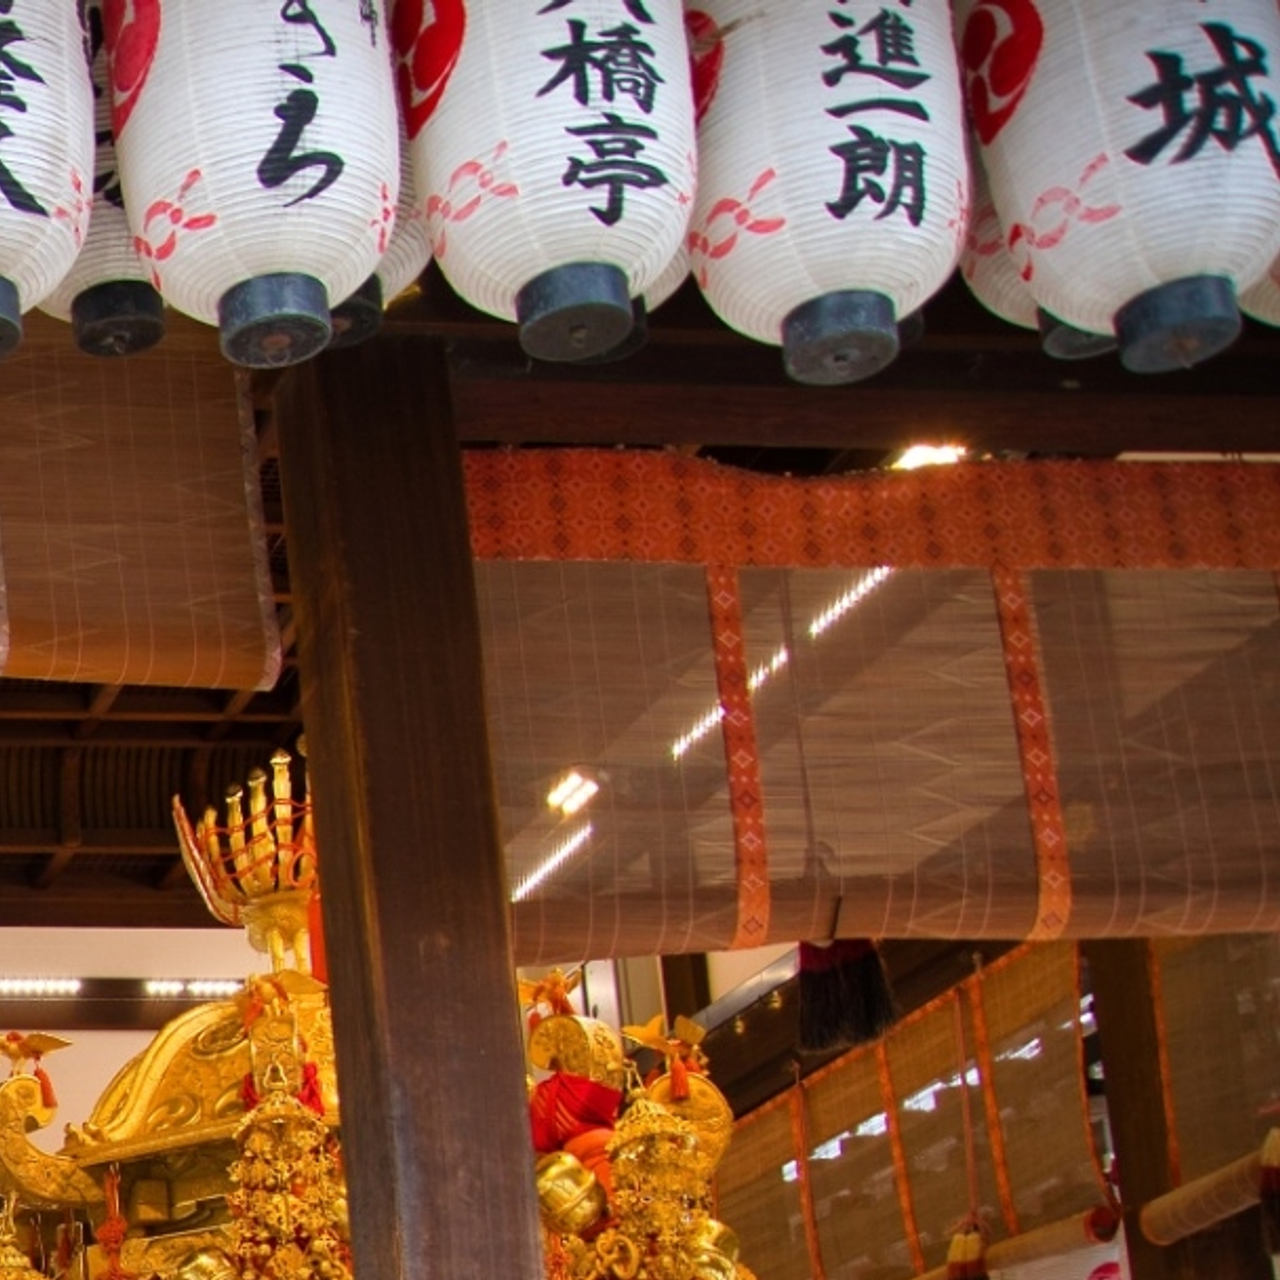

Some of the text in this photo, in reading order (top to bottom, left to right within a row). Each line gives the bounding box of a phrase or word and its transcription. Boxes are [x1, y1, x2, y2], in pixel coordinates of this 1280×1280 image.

[534, 0, 669, 227] 橋亭
[819, 0, 932, 228] 進一朗
